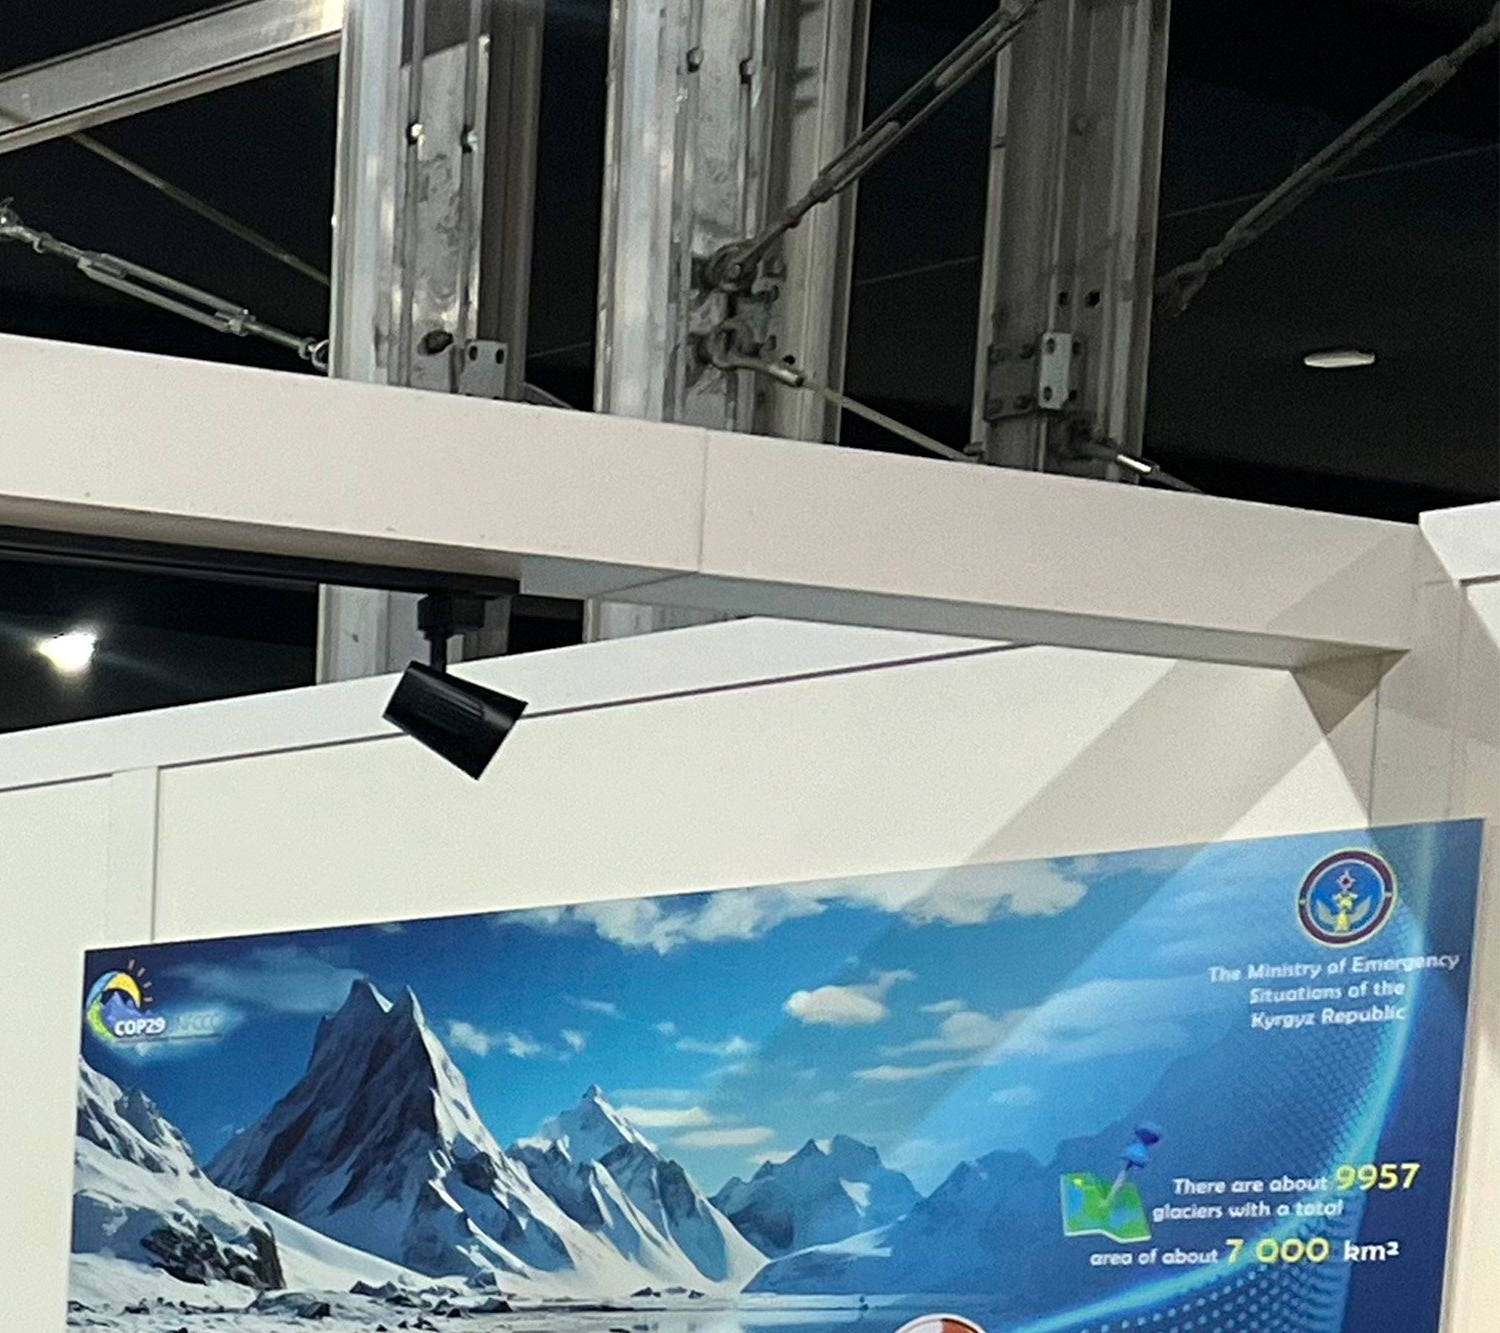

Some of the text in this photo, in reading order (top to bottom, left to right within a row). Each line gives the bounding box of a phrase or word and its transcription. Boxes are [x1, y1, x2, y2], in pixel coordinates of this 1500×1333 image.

[1208, 953, 1460, 983] The Ministry of Emergency
[1249, 979, 1405, 1005] Situations of the
[114, 1017, 166, 1036] COP29
[1251, 1005, 1405, 1030] Kyrgyz Republic
[1172, 1162, 1421, 1195] There are about 9957
[1152, 1199, 1344, 1223] glaciers with a total
[1090, 1252, 1133, 1267] area
[1138, 1248, 1158, 1266] of
[1162, 1247, 1218, 1264] about
